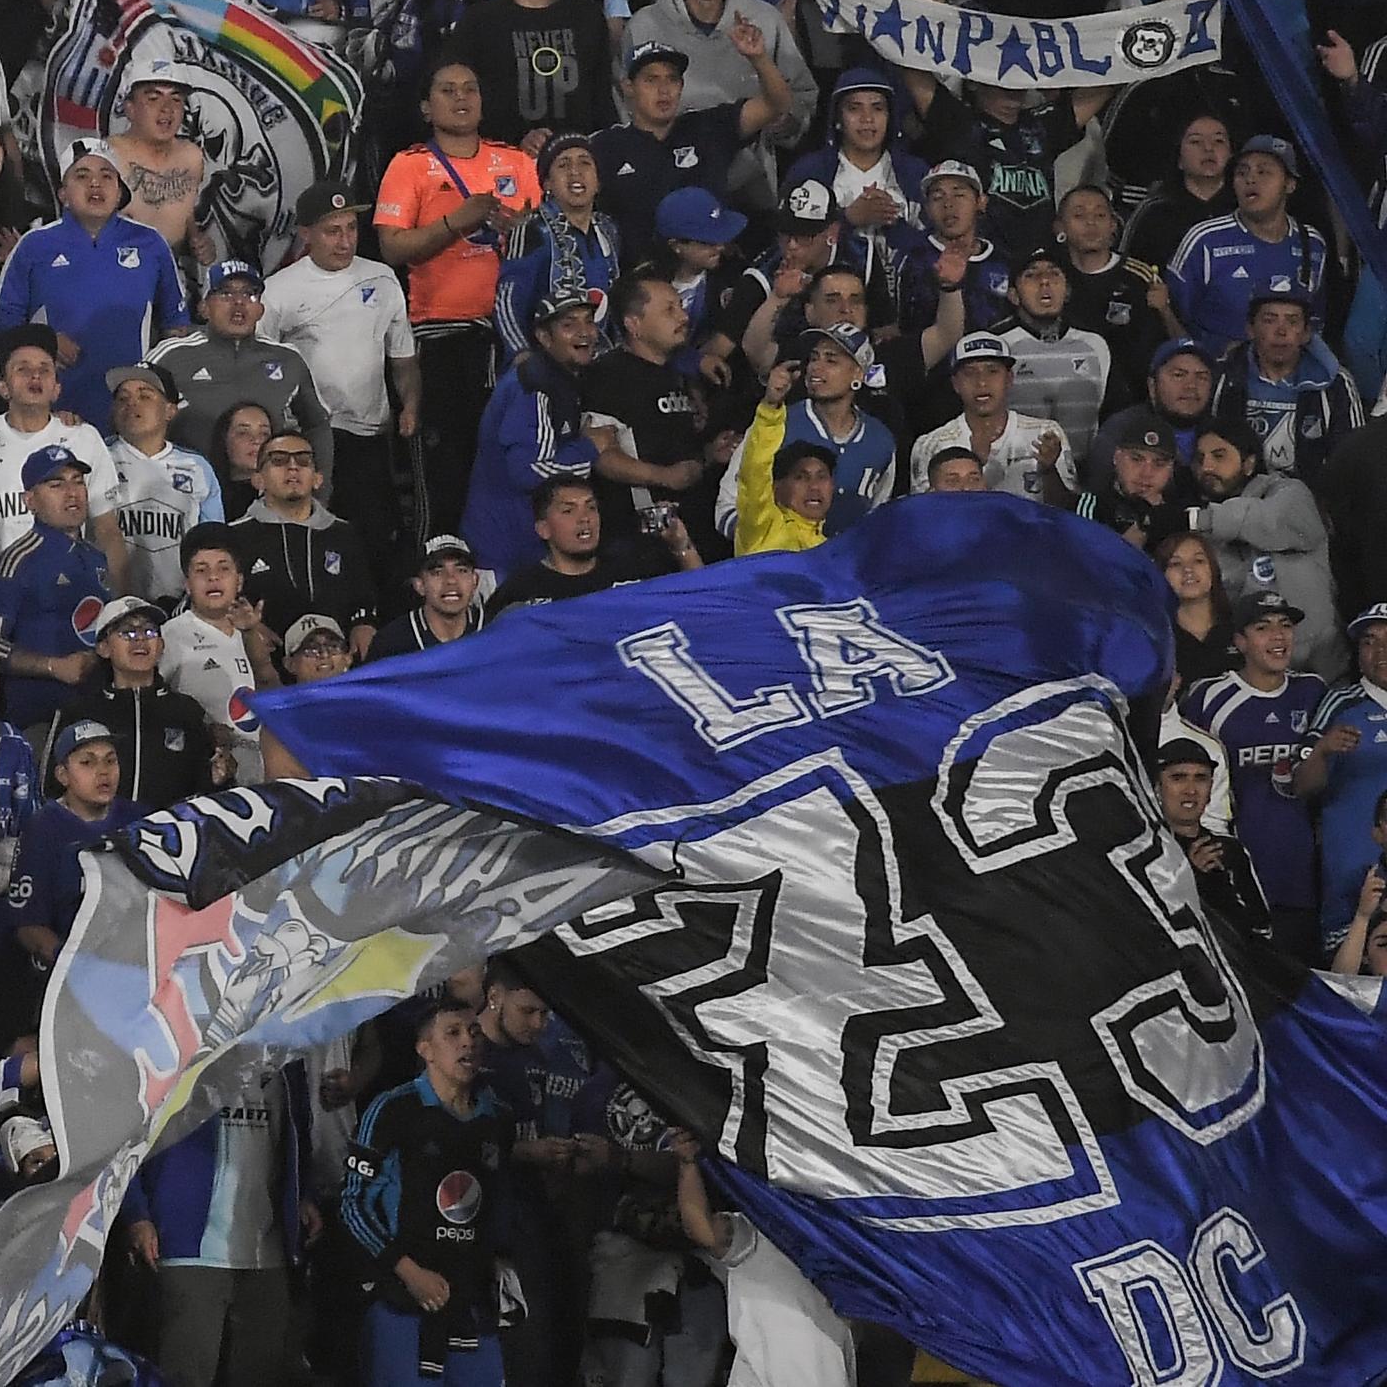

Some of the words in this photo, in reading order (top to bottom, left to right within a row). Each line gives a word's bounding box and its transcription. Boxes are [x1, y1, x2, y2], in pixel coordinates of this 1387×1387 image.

[117, 509, 185, 541] ANDINA
[233, 657, 249, 674] 13
[614, 595, 957, 753] LA
[434, 1225, 477, 1245] pepsi
[1072, 1205, 1308, 1387] DC
